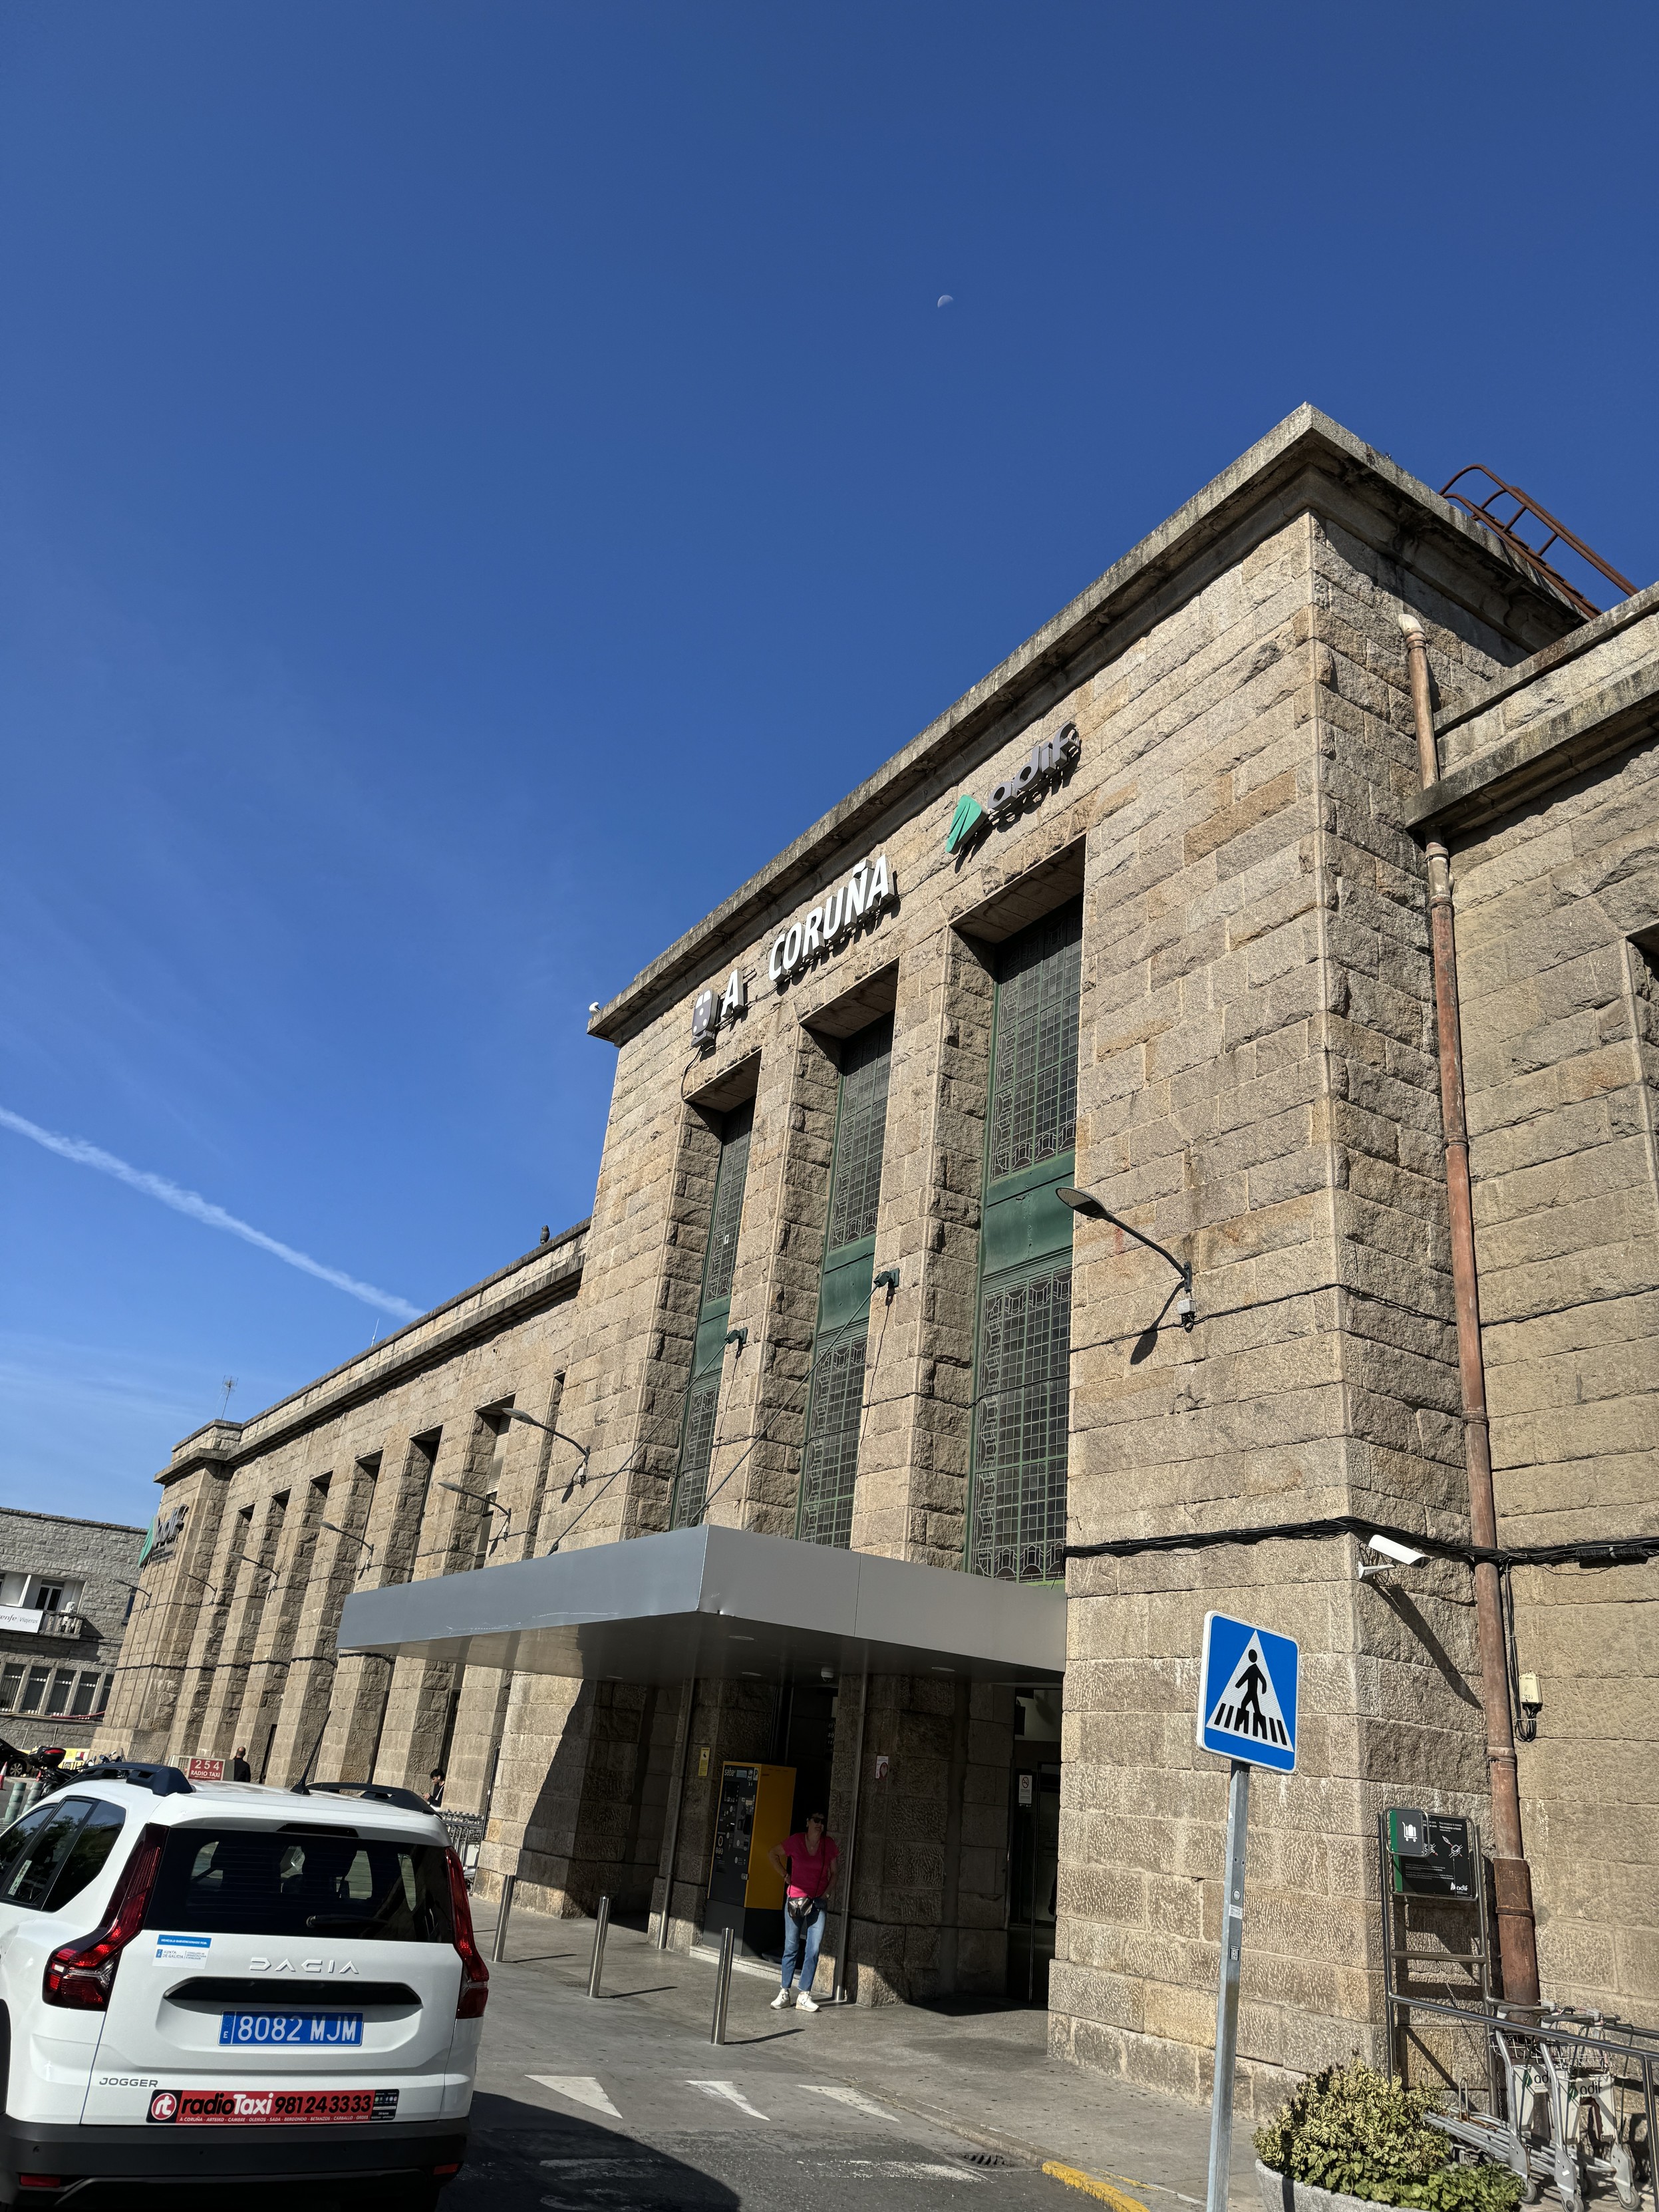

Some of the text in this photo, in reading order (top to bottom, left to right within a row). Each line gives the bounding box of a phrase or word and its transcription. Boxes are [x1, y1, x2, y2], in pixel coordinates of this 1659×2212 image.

[988, 720, 1078, 810] adif
[721, 854, 894, 1018] A CORUÑA
[0, 1614, 17, 1623] enfe
[249, 1957, 360, 1975] DACIA
[237, 2016, 303, 2042] 8082
[309, 2016, 357, 2042] MJM
[99, 2078, 158, 2088] JOGGER
[1580, 2080, 1602, 2095] adif
[180, 2092, 274, 2116] radioTaxi
